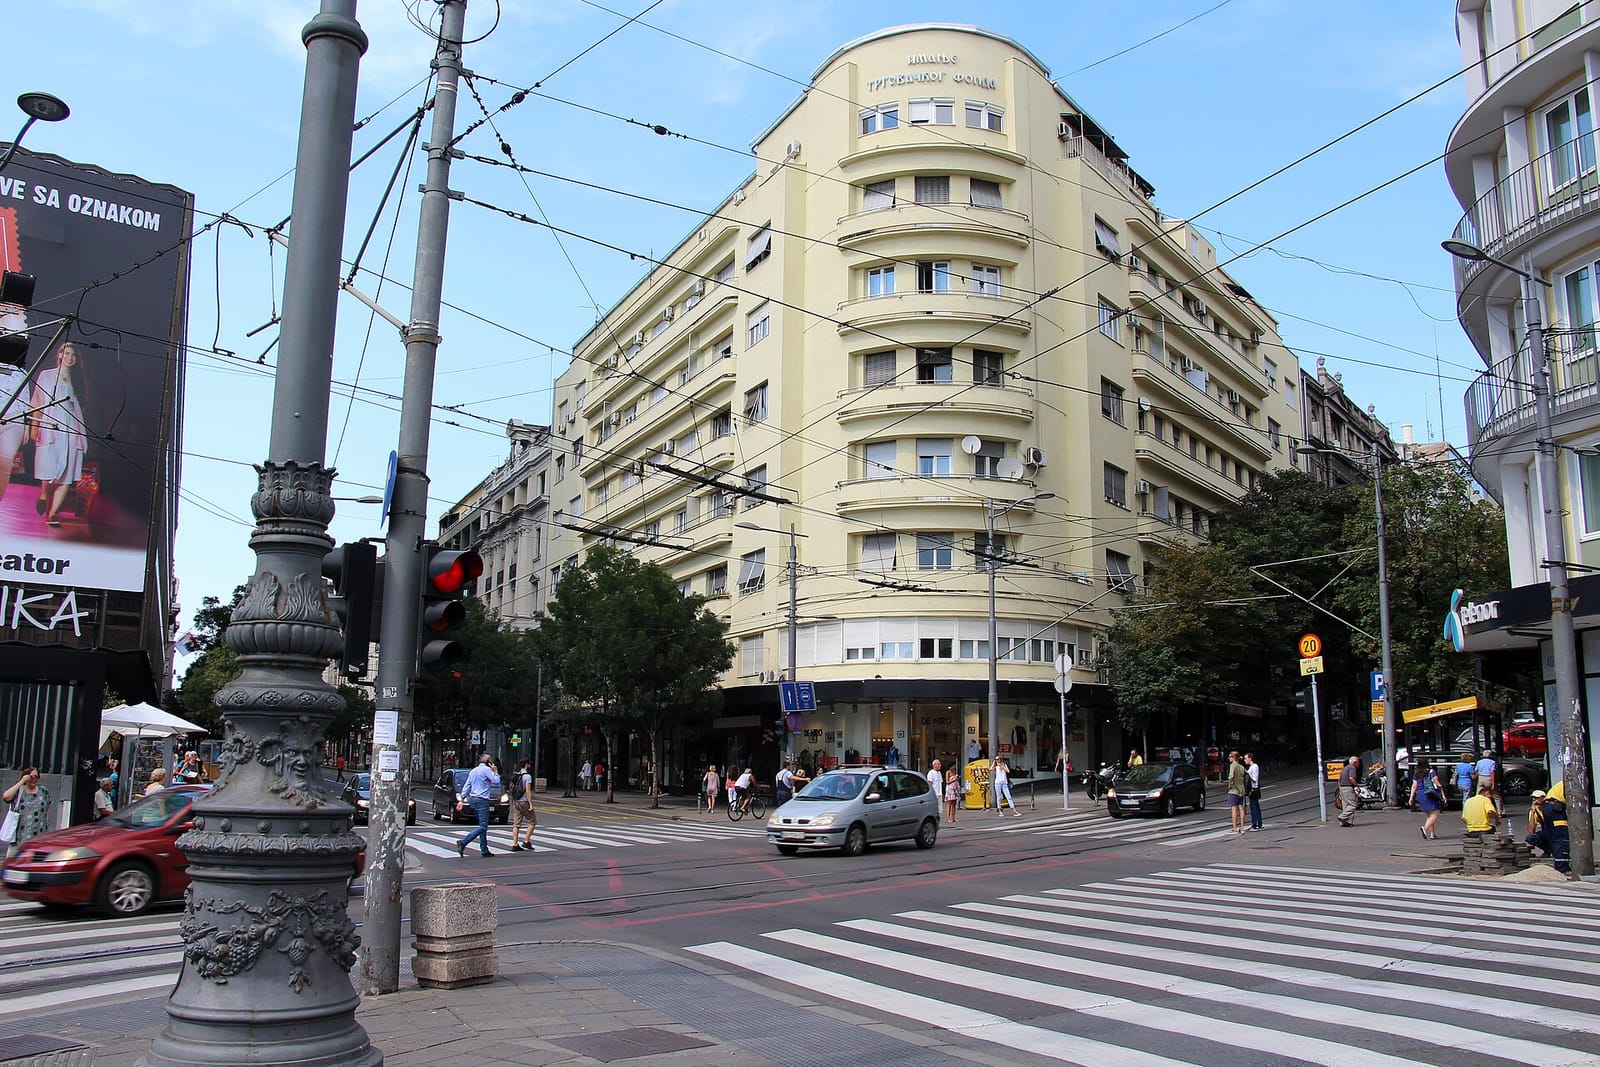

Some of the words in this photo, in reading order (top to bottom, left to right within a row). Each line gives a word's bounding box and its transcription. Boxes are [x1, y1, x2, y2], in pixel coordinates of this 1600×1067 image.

[33, 185, 60, 209] SA
[68, 193, 161, 232] OZNAKOM
[0, 553, 70, 575] ator
[1303, 639, 1317, 653] 20
[1374, 674, 1384, 691] P
